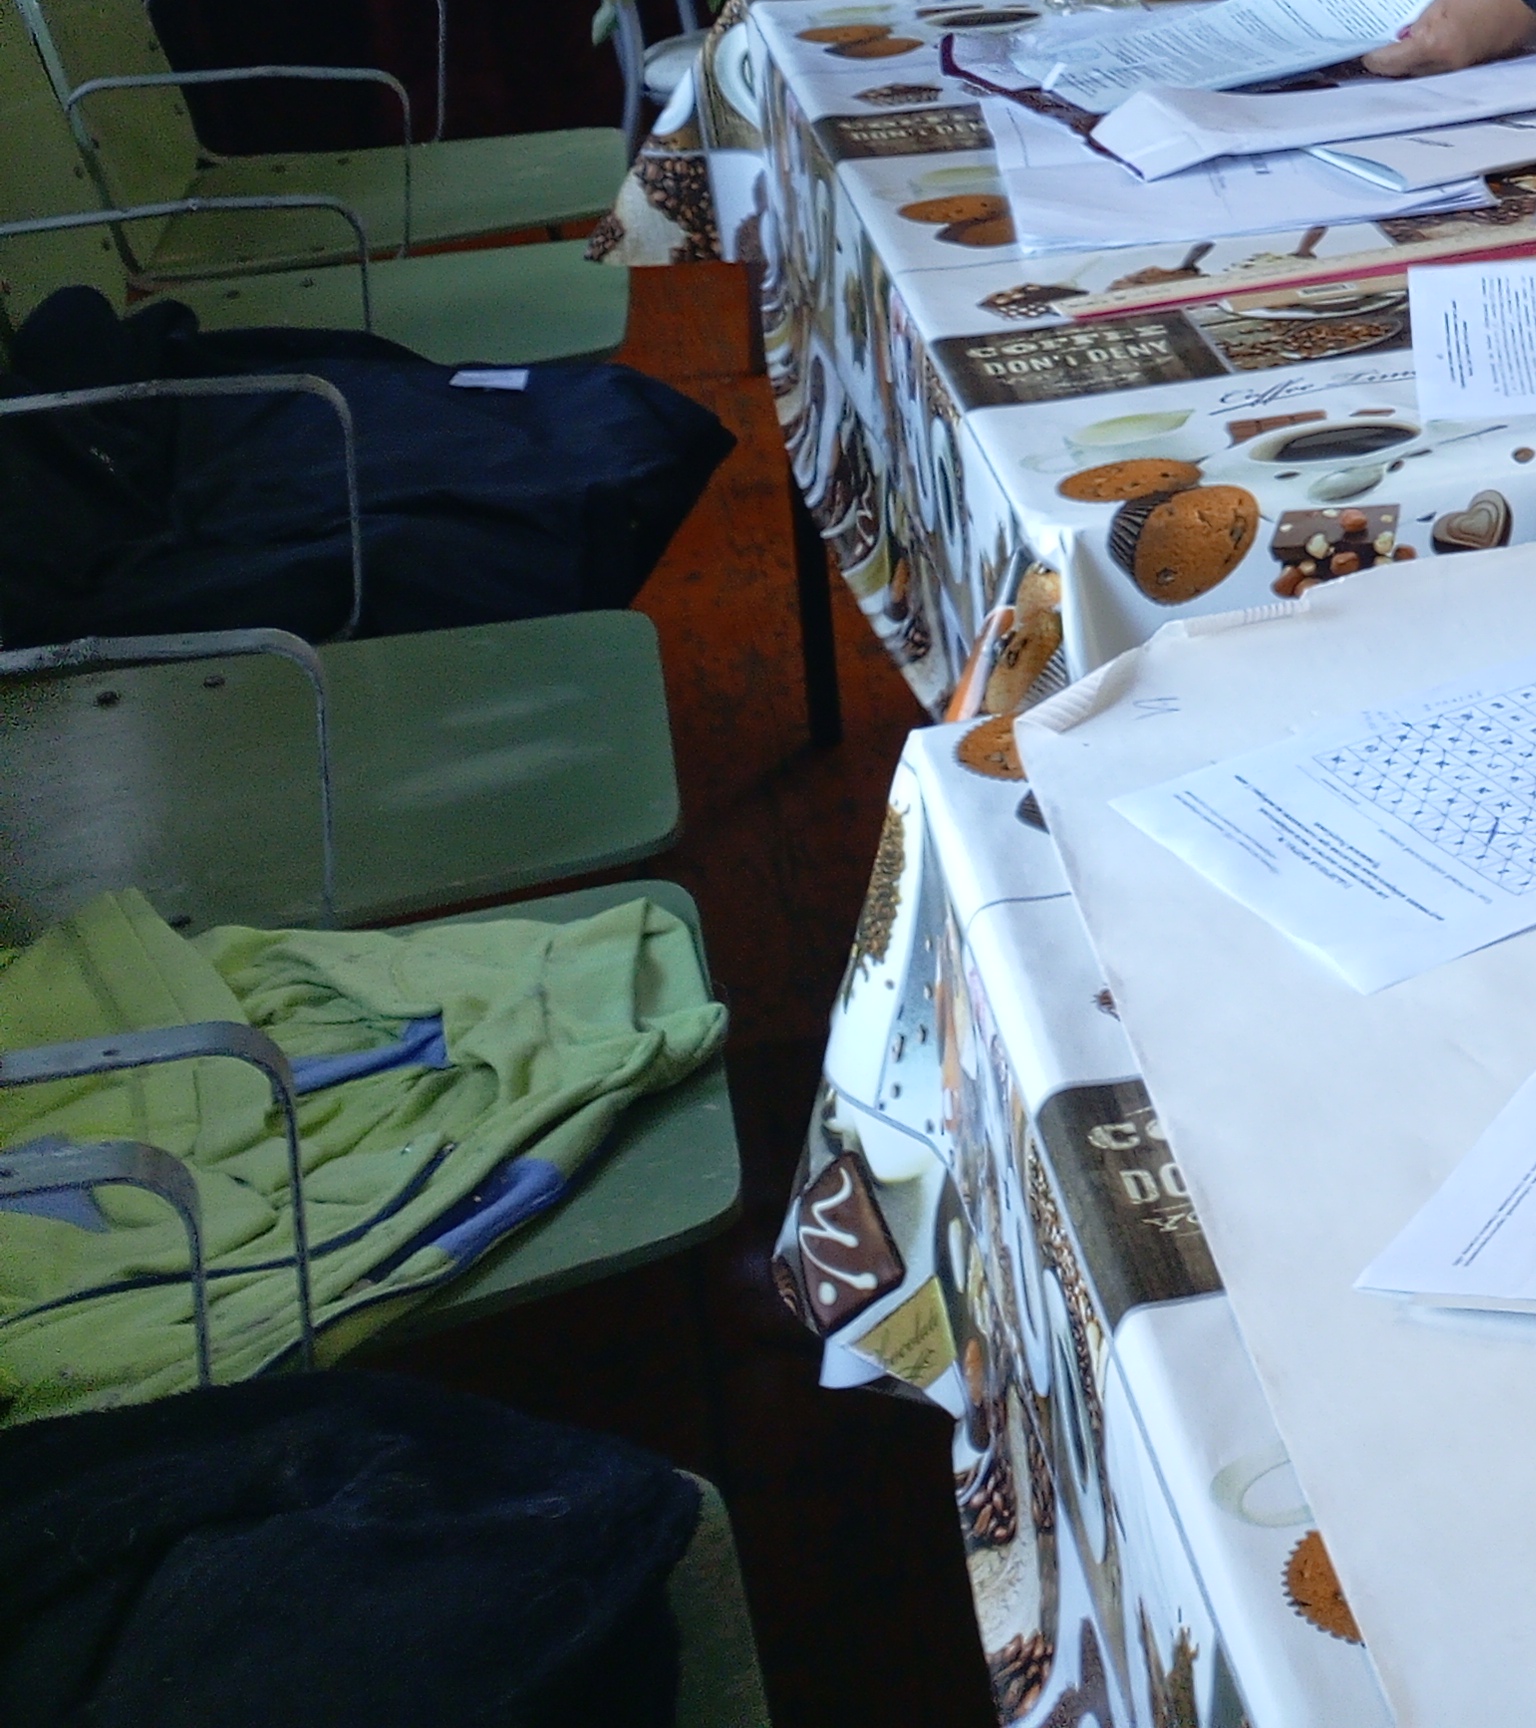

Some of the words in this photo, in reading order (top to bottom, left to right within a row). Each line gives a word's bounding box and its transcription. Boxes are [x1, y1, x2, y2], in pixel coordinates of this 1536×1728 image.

[966, 324, 1168, 360] COFFEE
[982, 353, 1078, 377] DON'T
[1086, 339, 1170, 364] DENY
